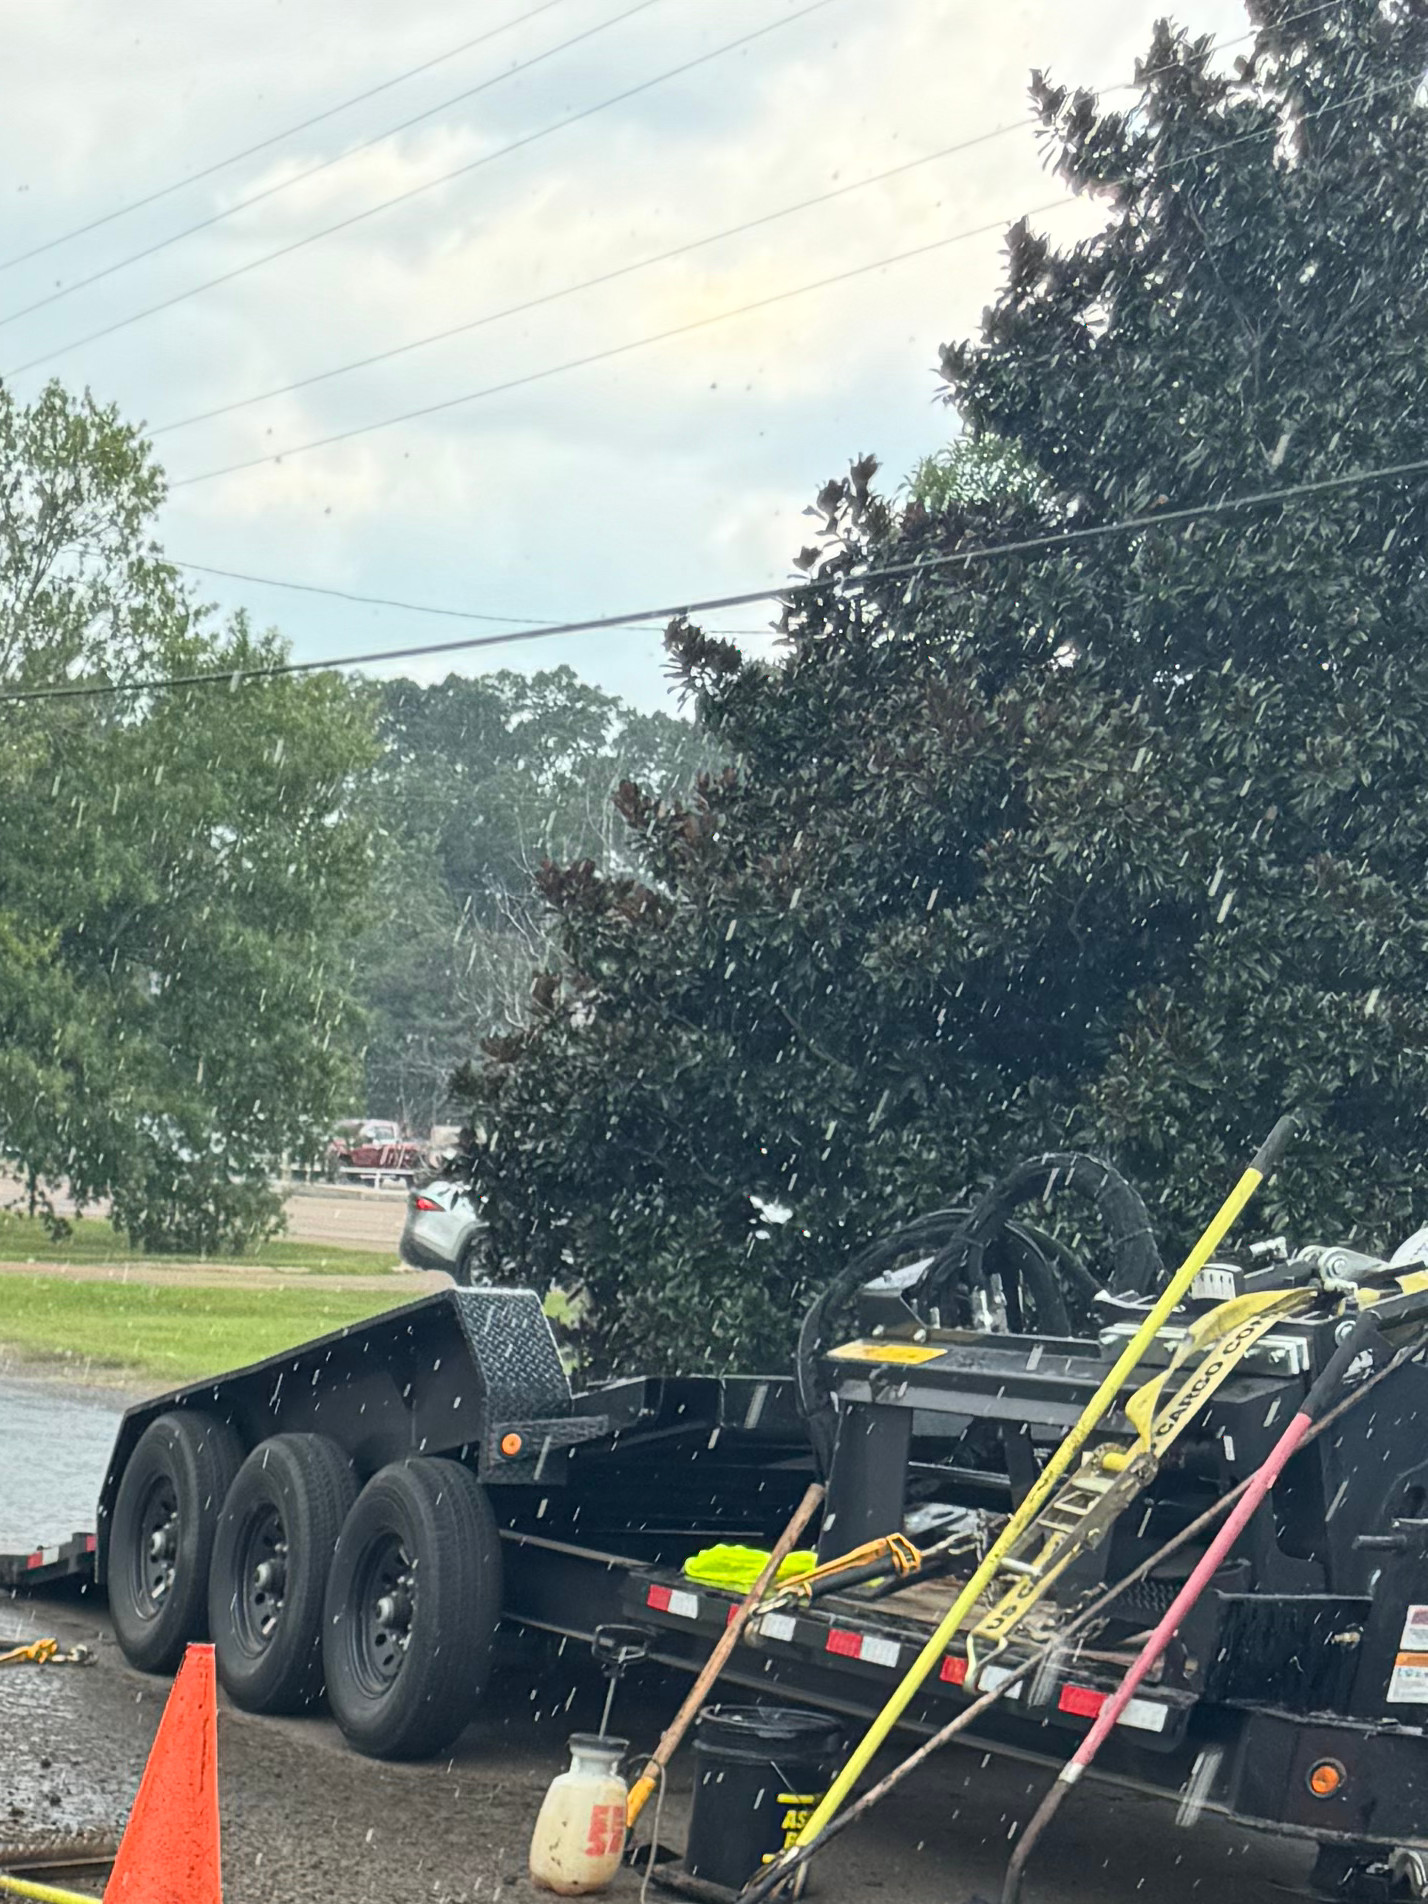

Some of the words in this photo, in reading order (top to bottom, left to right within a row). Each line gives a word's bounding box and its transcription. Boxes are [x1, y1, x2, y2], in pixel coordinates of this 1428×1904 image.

[1156, 1361, 1223, 1437] CARGO
[986, 1604, 1018, 1630] US
[781, 1809, 815, 1830] AS
